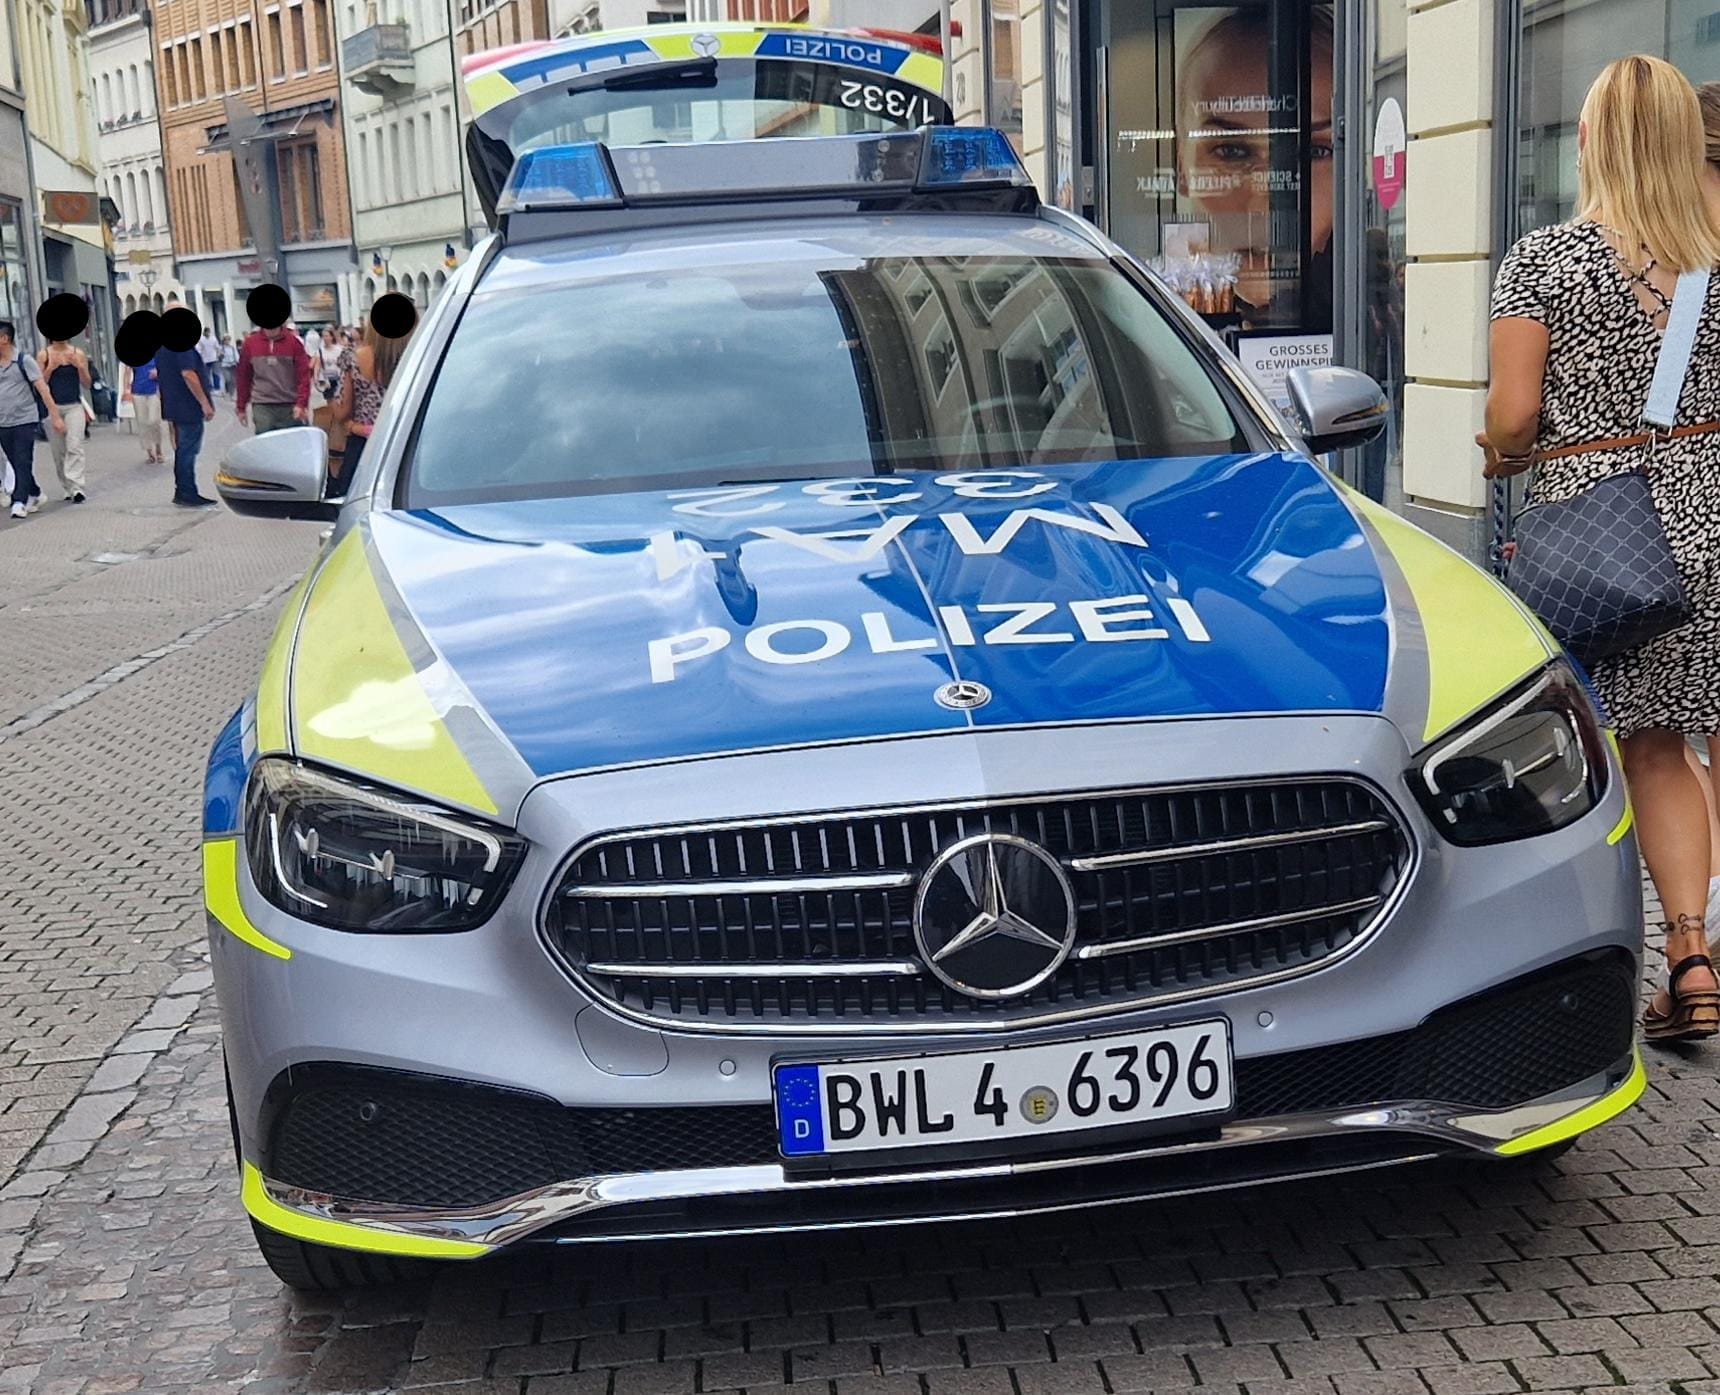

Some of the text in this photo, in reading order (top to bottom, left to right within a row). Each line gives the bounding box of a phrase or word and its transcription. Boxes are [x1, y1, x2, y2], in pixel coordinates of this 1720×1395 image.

[785, 39, 882, 65] POLIZEI
[840, 79, 935, 124] 1/332
[1255, 357, 1333, 370] GEWINNSPI
[1269, 344, 1329, 356] GROSSES
[666, 471, 1059, 517] 332
[648, 594, 1212, 684] POLIZEI
[825, 1033, 1220, 1141] BWL 4 6396
[794, 1119, 810, 1139] D
